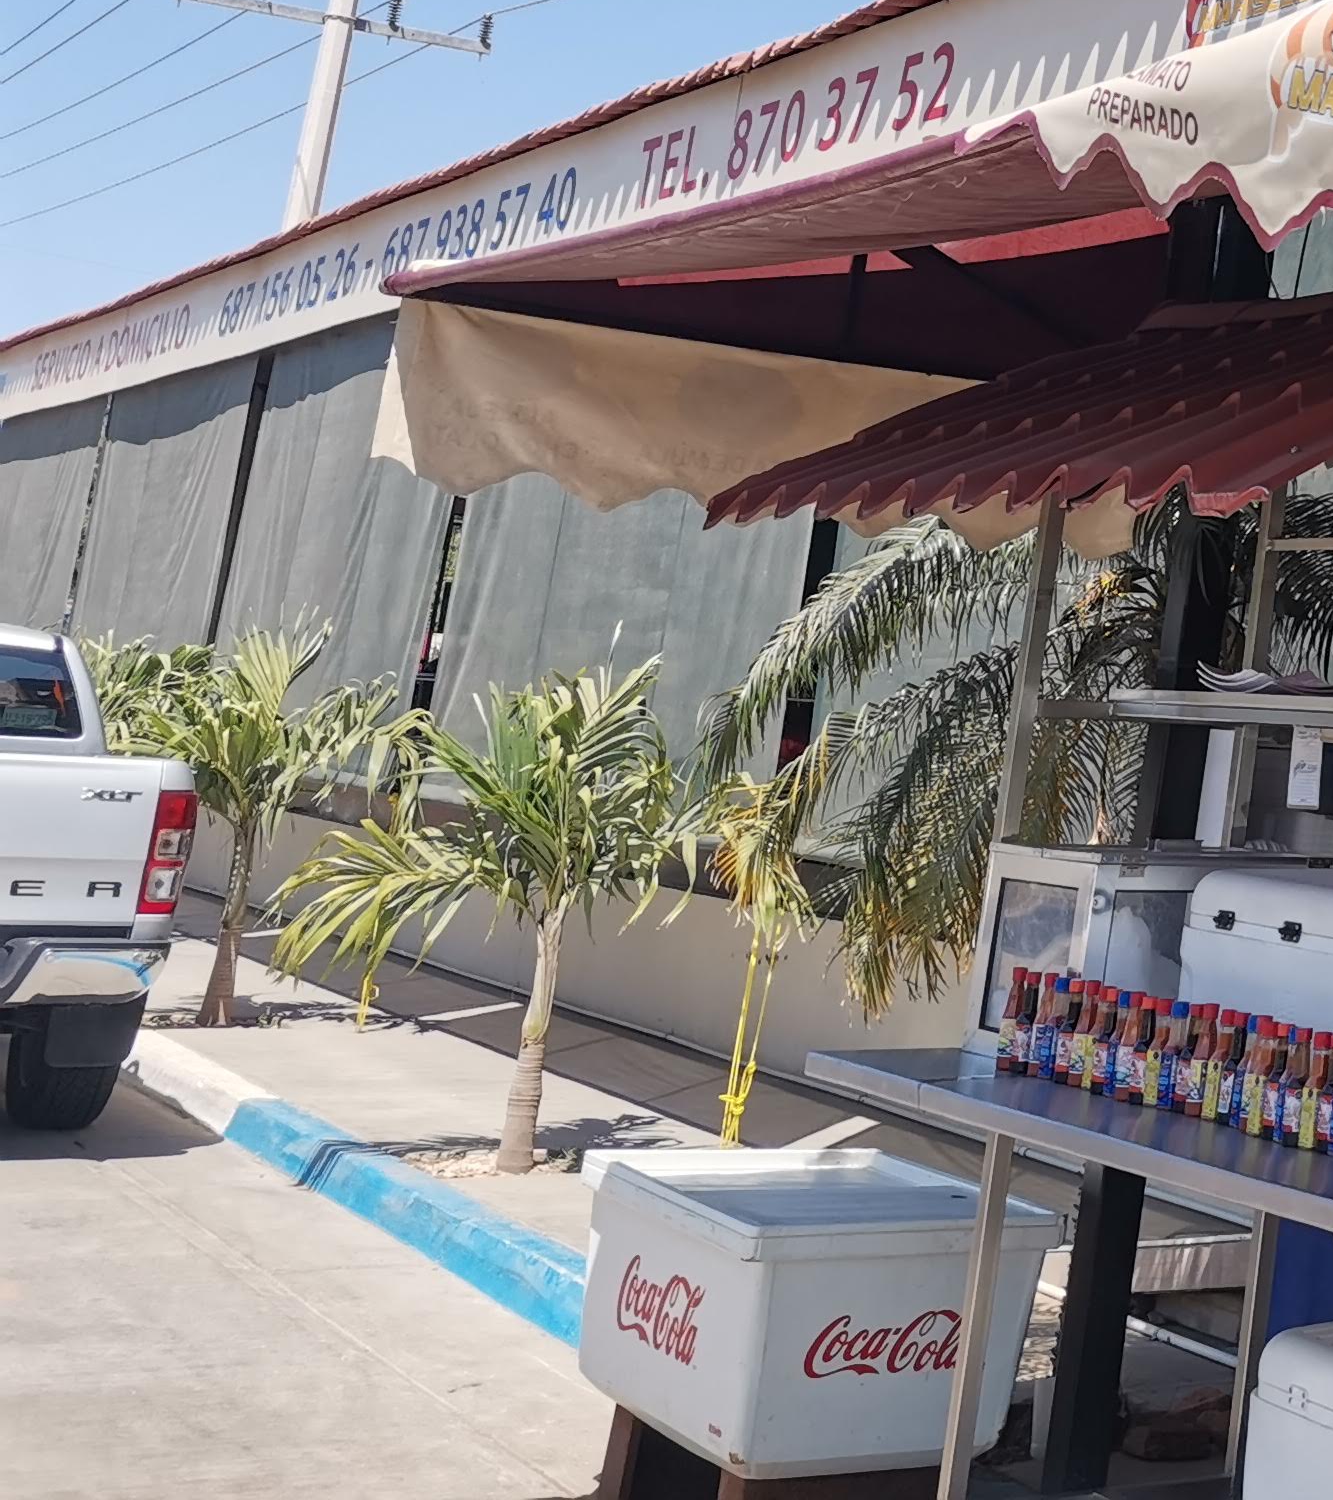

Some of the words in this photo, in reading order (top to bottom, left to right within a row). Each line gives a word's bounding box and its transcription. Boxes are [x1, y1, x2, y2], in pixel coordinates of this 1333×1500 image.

[641, 125, 710, 209] TEL.
[727, 89, 806, 181] 870
[817, 65, 880, 152] 37
[891, 41, 955, 132] 52
[1086, 86, 1199, 146] PREPARADO
[31, 338, 92, 393] SERVICIO
[103, 303, 191, 373] DOMICILIO
[218, 280, 257, 338] 687
[257, 265, 295, 322] 156
[295, 254, 327, 312] 05
[326, 242, 361, 302] 26
[381, 216, 432, 276] 687
[436, 198, 485, 260] 938
[490, 182, 532, 251] 57
[537, 166, 577, 235] 40
[616, 1254, 705, 1368] Coca-Cola
